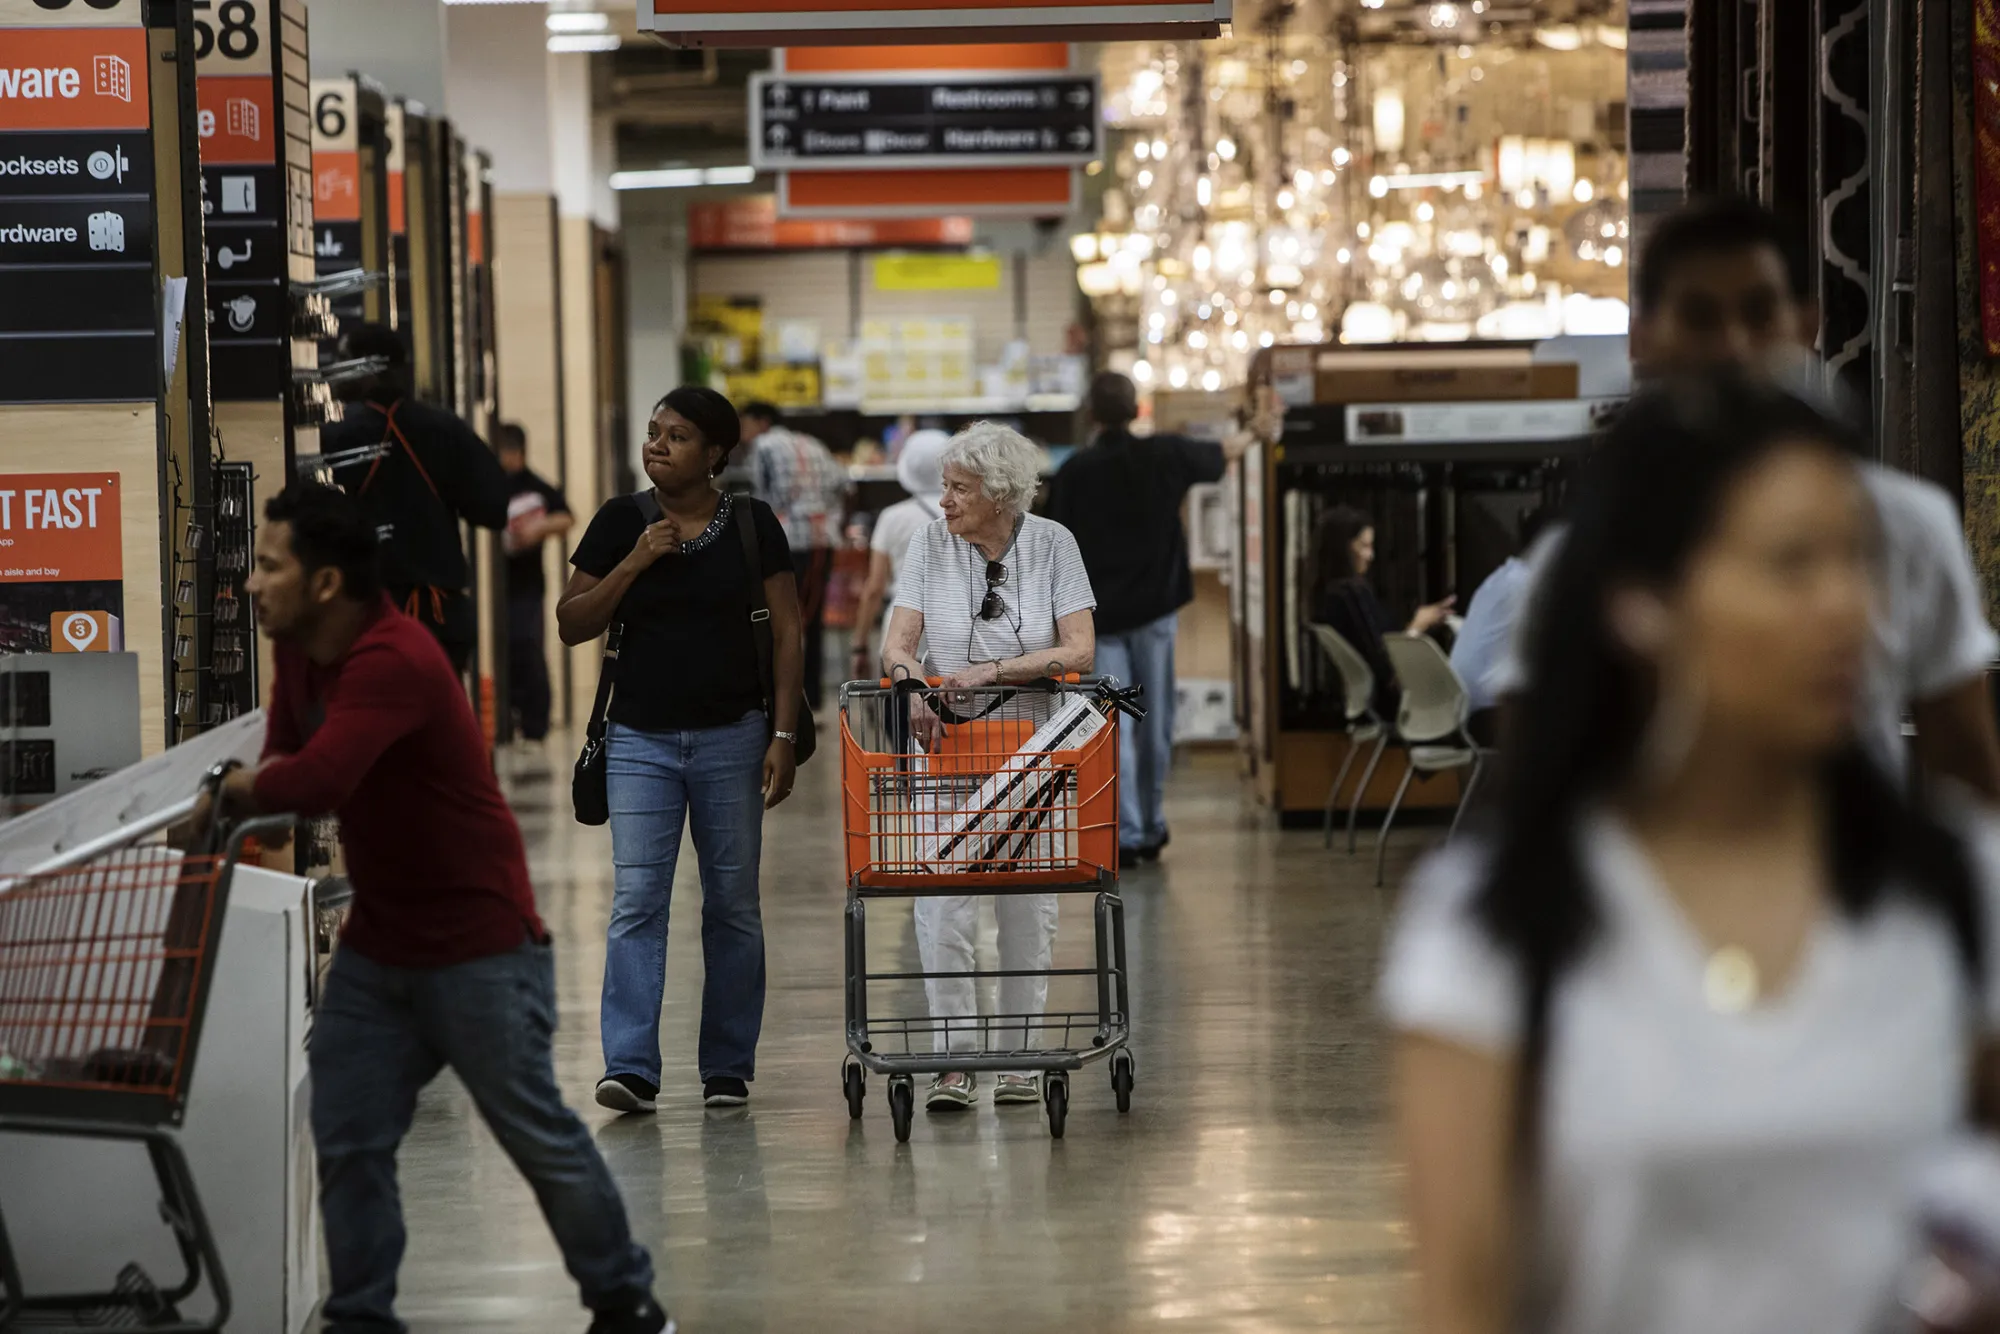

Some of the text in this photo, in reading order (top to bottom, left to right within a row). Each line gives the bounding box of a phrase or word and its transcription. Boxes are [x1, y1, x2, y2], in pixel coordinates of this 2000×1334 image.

[0, 67, 80, 98] ware
[25, 488, 102, 529] FAST
[4, 568, 24, 577] aisle
[26, 568, 42, 576] and
[44, 567, 60, 577] bay
[75, 625, 86, 637] 3
